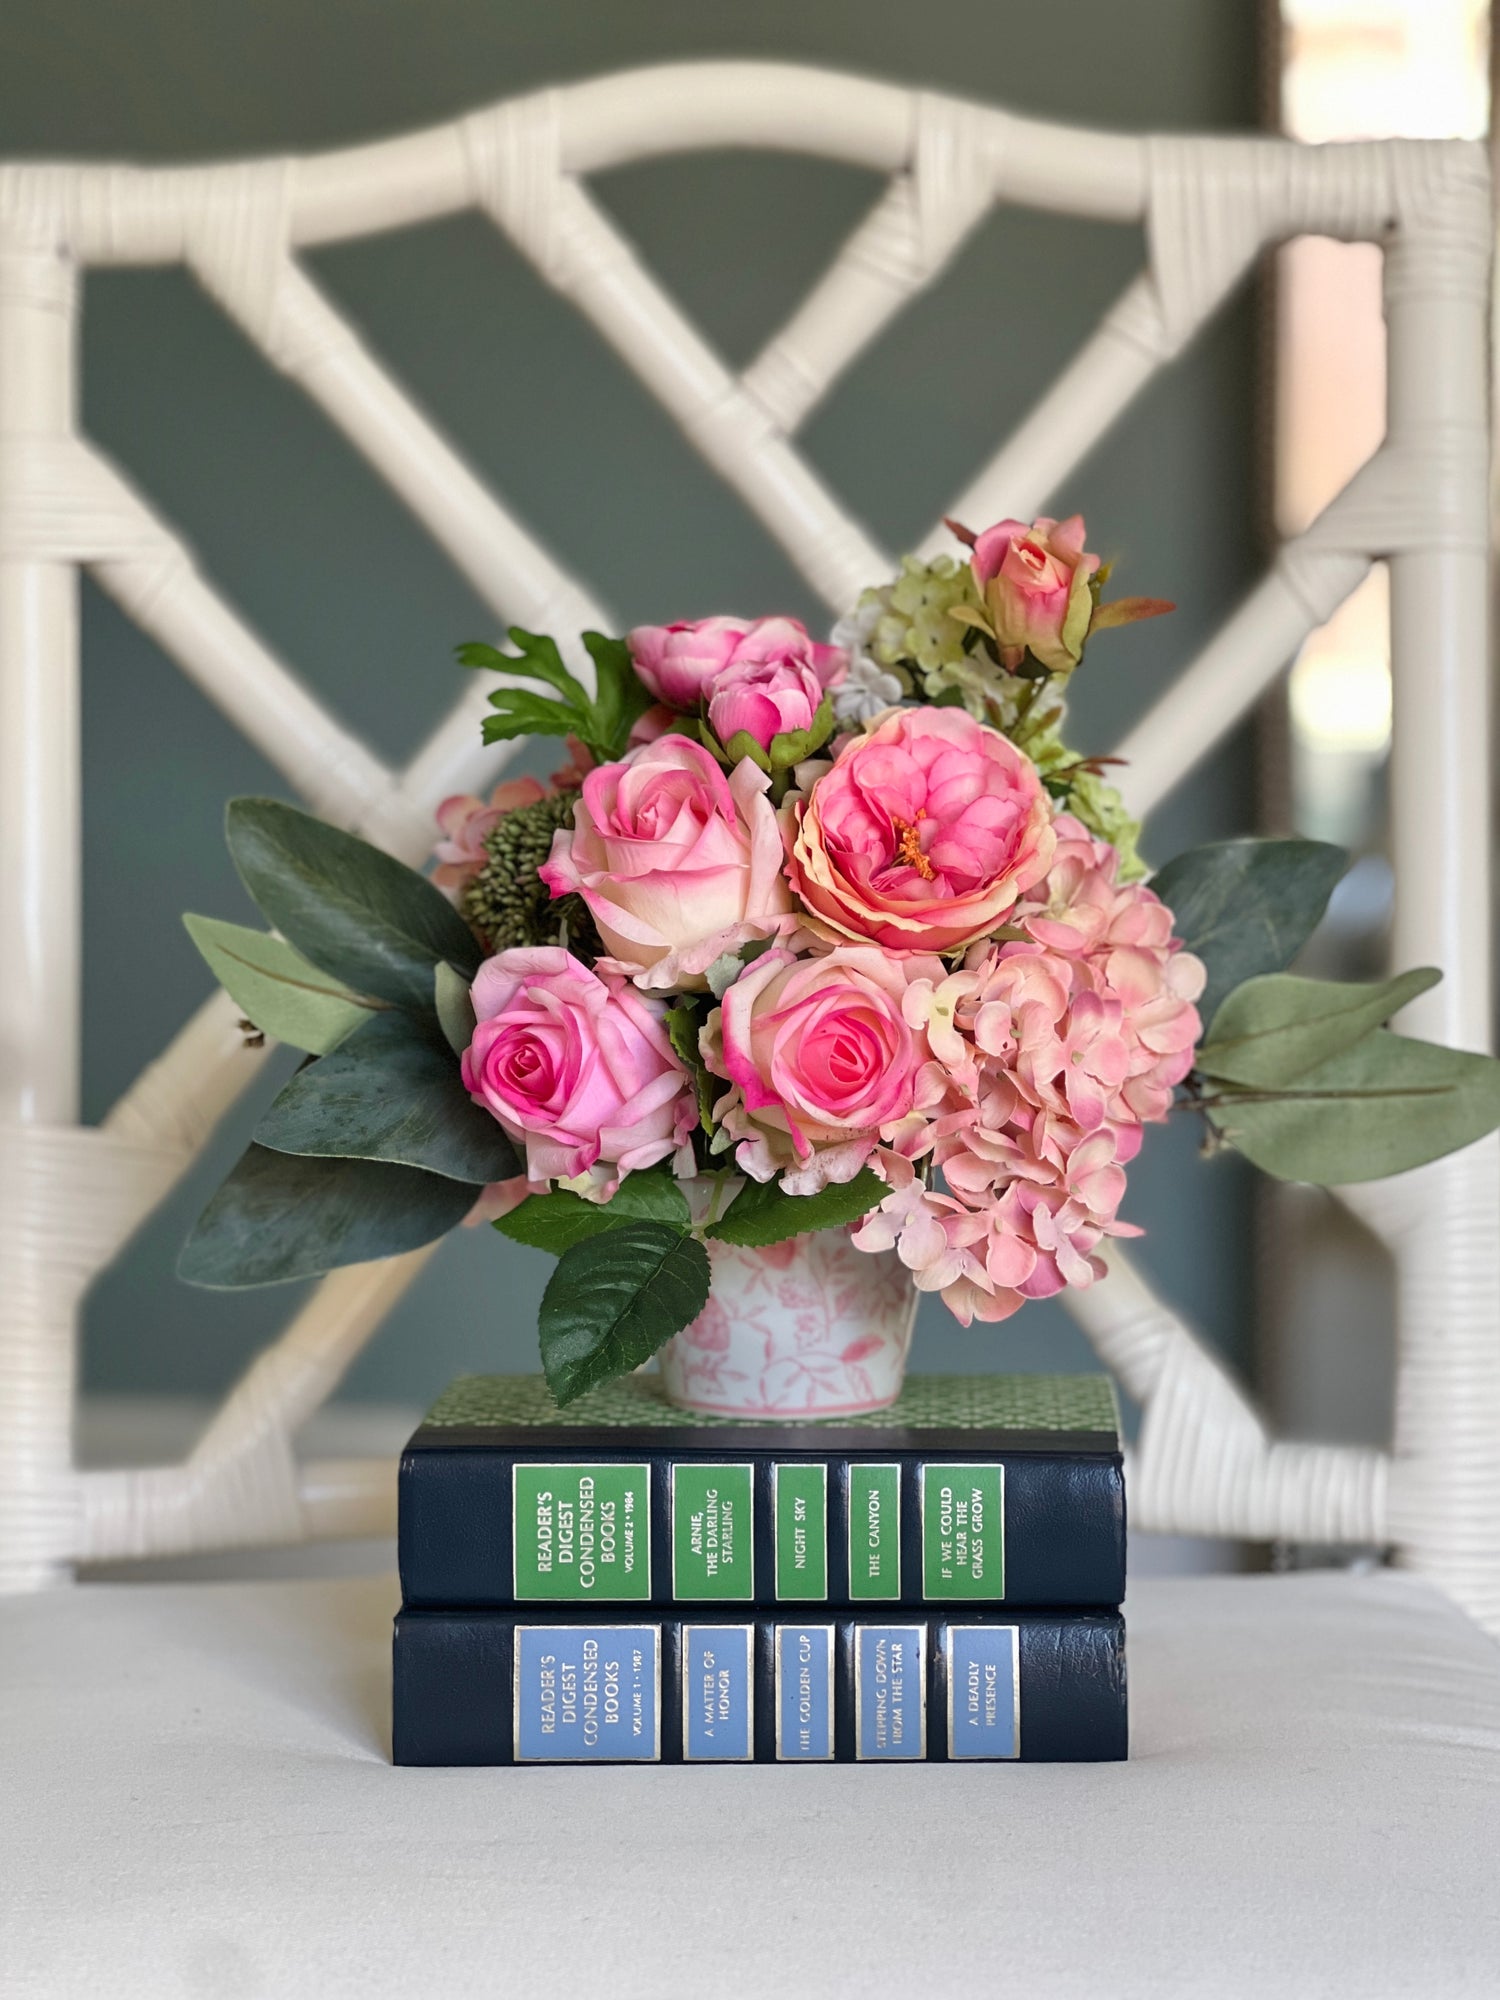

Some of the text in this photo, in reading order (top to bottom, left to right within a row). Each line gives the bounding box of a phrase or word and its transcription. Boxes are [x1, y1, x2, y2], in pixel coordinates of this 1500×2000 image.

[537, 1491, 552, 1571] READER'S
[558, 1500, 573, 1563] DIGEST
[579, 1476, 595, 1588] CONDENSED
[600, 1501, 616, 1562] BOOKS
[624, 1491, 634, 1513] 1984
[691, 1511, 704, 1555] ARNIE,
[706, 1489, 718, 1577] THE DARLING
[722, 1500, 733, 1564] STARLING
[794, 1497, 806, 1569] NIGHT SKY
[940, 1487, 952, 1579] IF WE COULD
[956, 1501, 968, 1565] HEAR THE
[624, 1530, 634, 1573] VOLUME
[868, 1490, 880, 1578] THE CANYON
[971, 1488, 983, 1579] GRASS GROW
[633, 1649, 642, 1673] 1987
[799, 1634, 811, 1663] CUP
[875, 1639, 887, 1684] DOWN
[891, 1643, 903, 1673] STAR
[540, 1655, 555, 1734] READER'S
[562, 1662, 576, 1723] DIGEST
[583, 1639, 599, 1746] CONDENSED
[604, 1661, 619, 1723] BOOKS
[633, 1692, 642, 1736] VOLUME
[703, 1650, 715, 1737] A MATTER OF
[718, 1669, 730, 1720] HONOR
[799, 1667, 811, 1723] GOLDEN
[891, 1678, 903, 1704] THE
[968, 1661, 980, 1726] A DEADLY
[985, 1664, 997, 1726] PRESENCE
